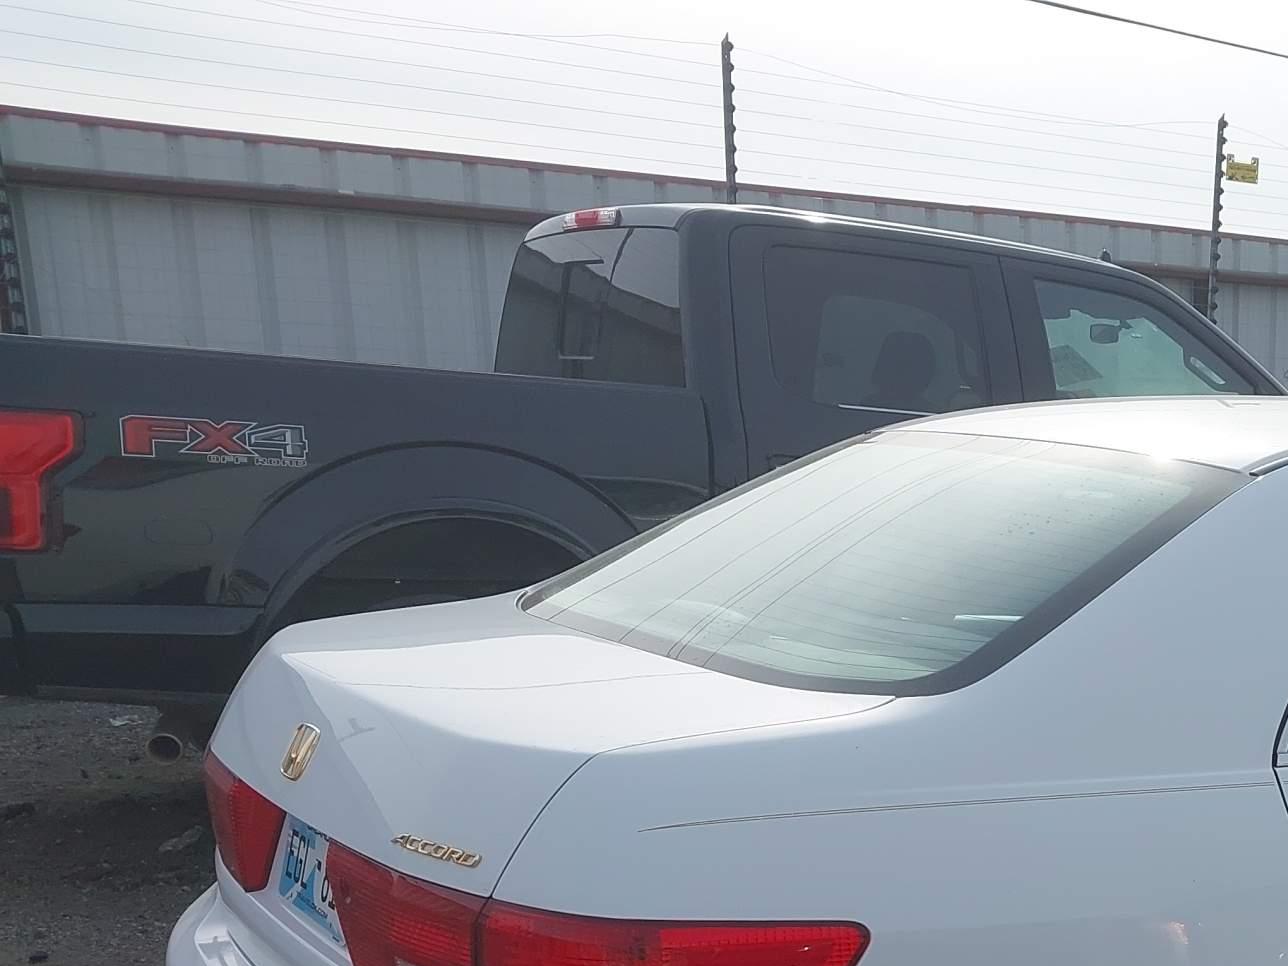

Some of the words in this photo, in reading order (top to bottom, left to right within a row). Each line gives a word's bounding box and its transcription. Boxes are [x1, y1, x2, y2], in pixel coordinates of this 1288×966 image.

[119, 414, 308, 460] FX4
[206, 454, 249, 465] OFF
[254, 458, 308, 468] ROAD
[390, 833, 483, 869] ACCORD
